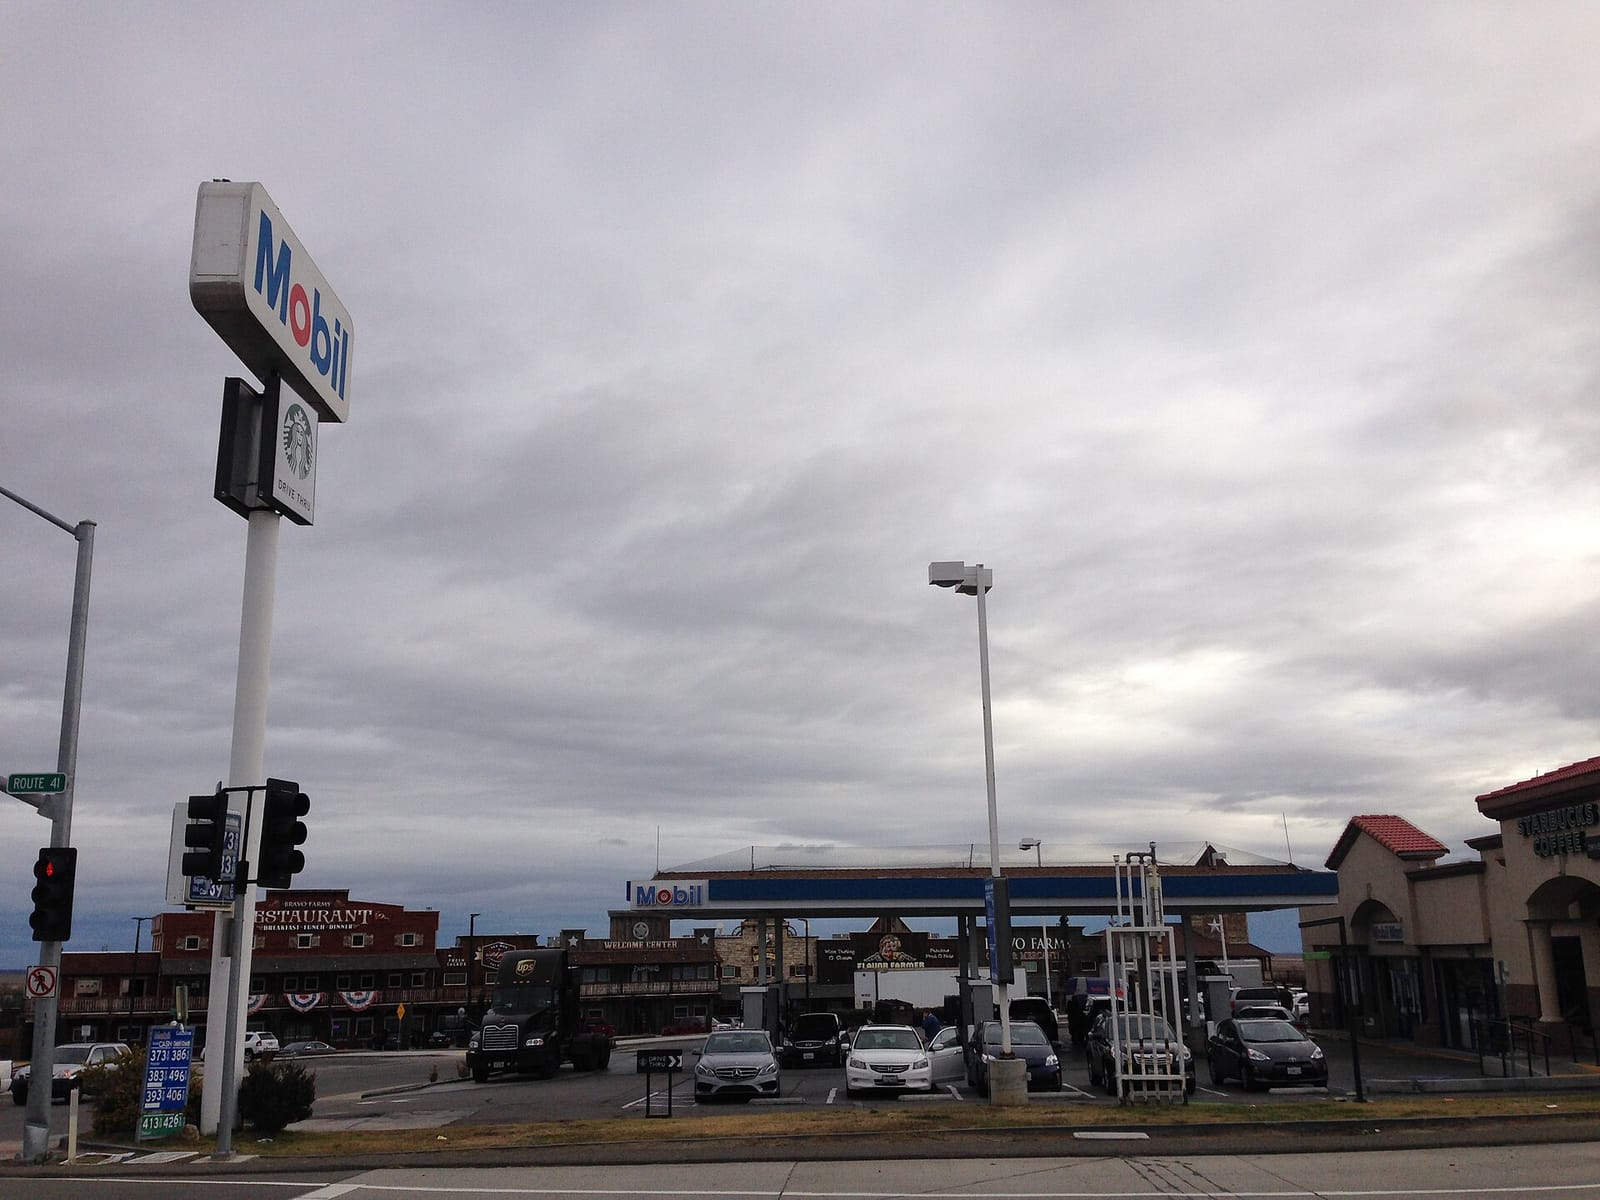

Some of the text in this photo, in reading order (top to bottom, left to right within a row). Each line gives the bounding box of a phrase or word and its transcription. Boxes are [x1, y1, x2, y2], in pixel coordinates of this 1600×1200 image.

[254, 209, 349, 401] Mobil
[278, 479, 311, 512] DRIVE THRU
[13, 777, 60, 790] ROUTE 41
[1519, 802, 1595, 836] STARBUCKS
[1534, 831, 1583, 857] COFFEE
[637, 886, 703, 905] Mobil
[255, 909, 373, 925] ESTAURANT
[604, 940, 678, 949] WELCOME CENTER
[516, 963, 535, 974] ups
[890, 961, 925, 969] FARMER
[150, 1049, 186, 1061] 373 386
[148, 1070, 184, 1082] 383 496
[145, 1090, 182, 1102] 393 406
[142, 1117, 159, 1129] 413
